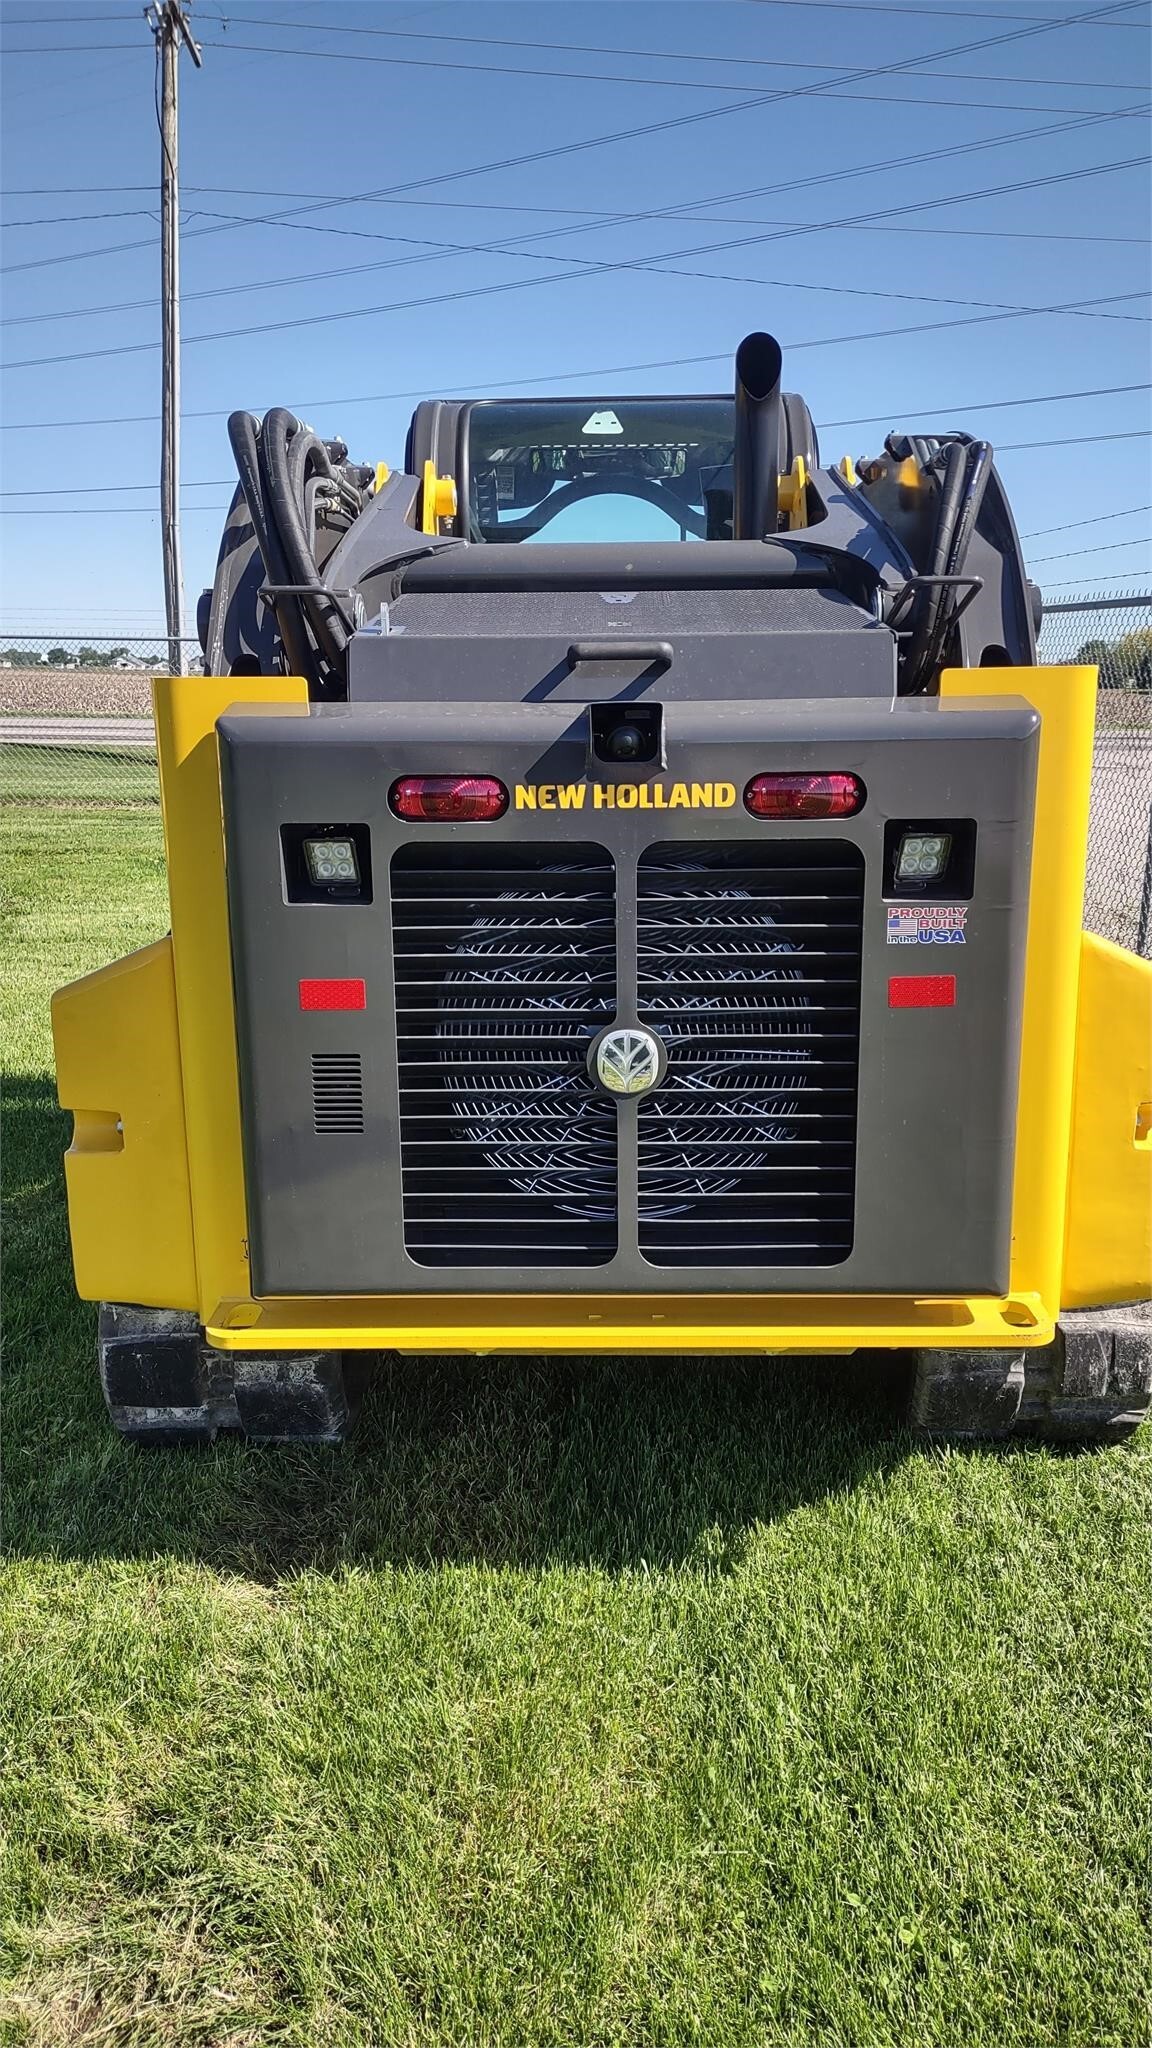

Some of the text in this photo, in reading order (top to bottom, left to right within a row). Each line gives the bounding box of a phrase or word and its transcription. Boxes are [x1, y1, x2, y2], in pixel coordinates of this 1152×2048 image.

[515, 782, 736, 809] NEW HOLLAND
[888, 907, 968, 918] PROUDLY
[919, 918, 967, 929] BUILT
[899, 935, 917, 944] the
[918, 930, 966, 944] USA
